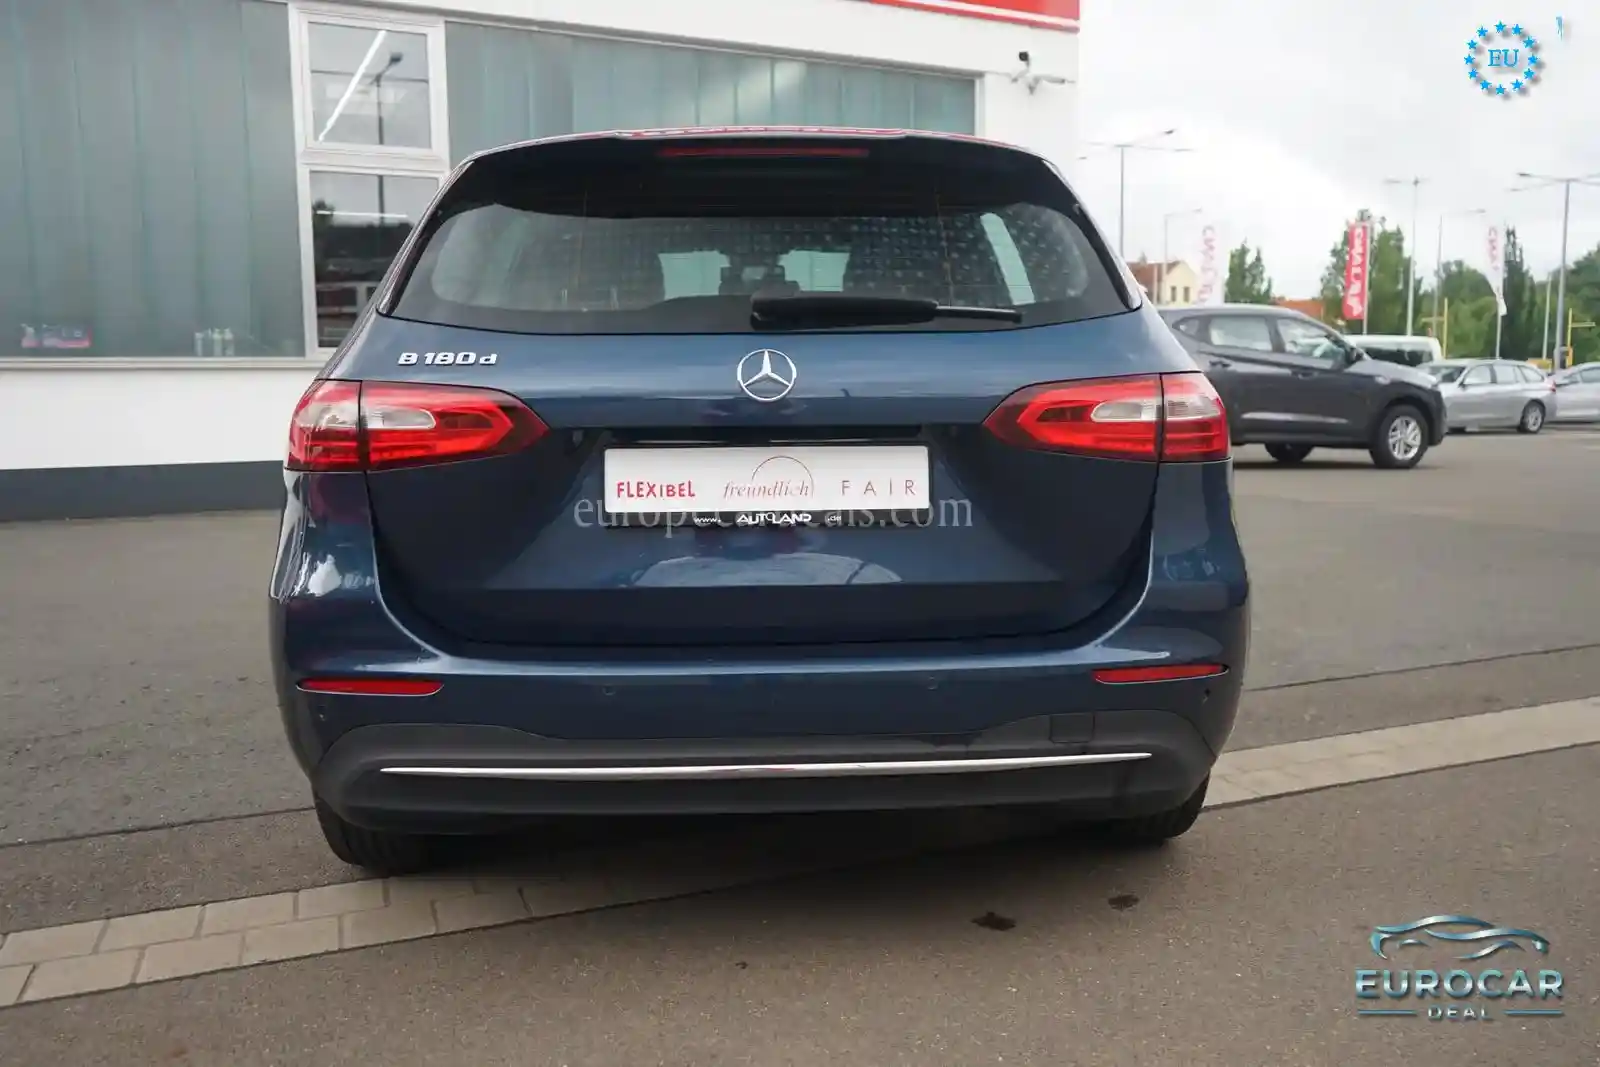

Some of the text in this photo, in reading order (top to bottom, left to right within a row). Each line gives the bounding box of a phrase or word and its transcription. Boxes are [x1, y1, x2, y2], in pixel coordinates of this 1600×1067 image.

[398, 352, 419, 366] B
[616, 478, 916, 500] FLEXIBEL freundlich FAIR
[736, 511, 812, 526] AUTOLAND
